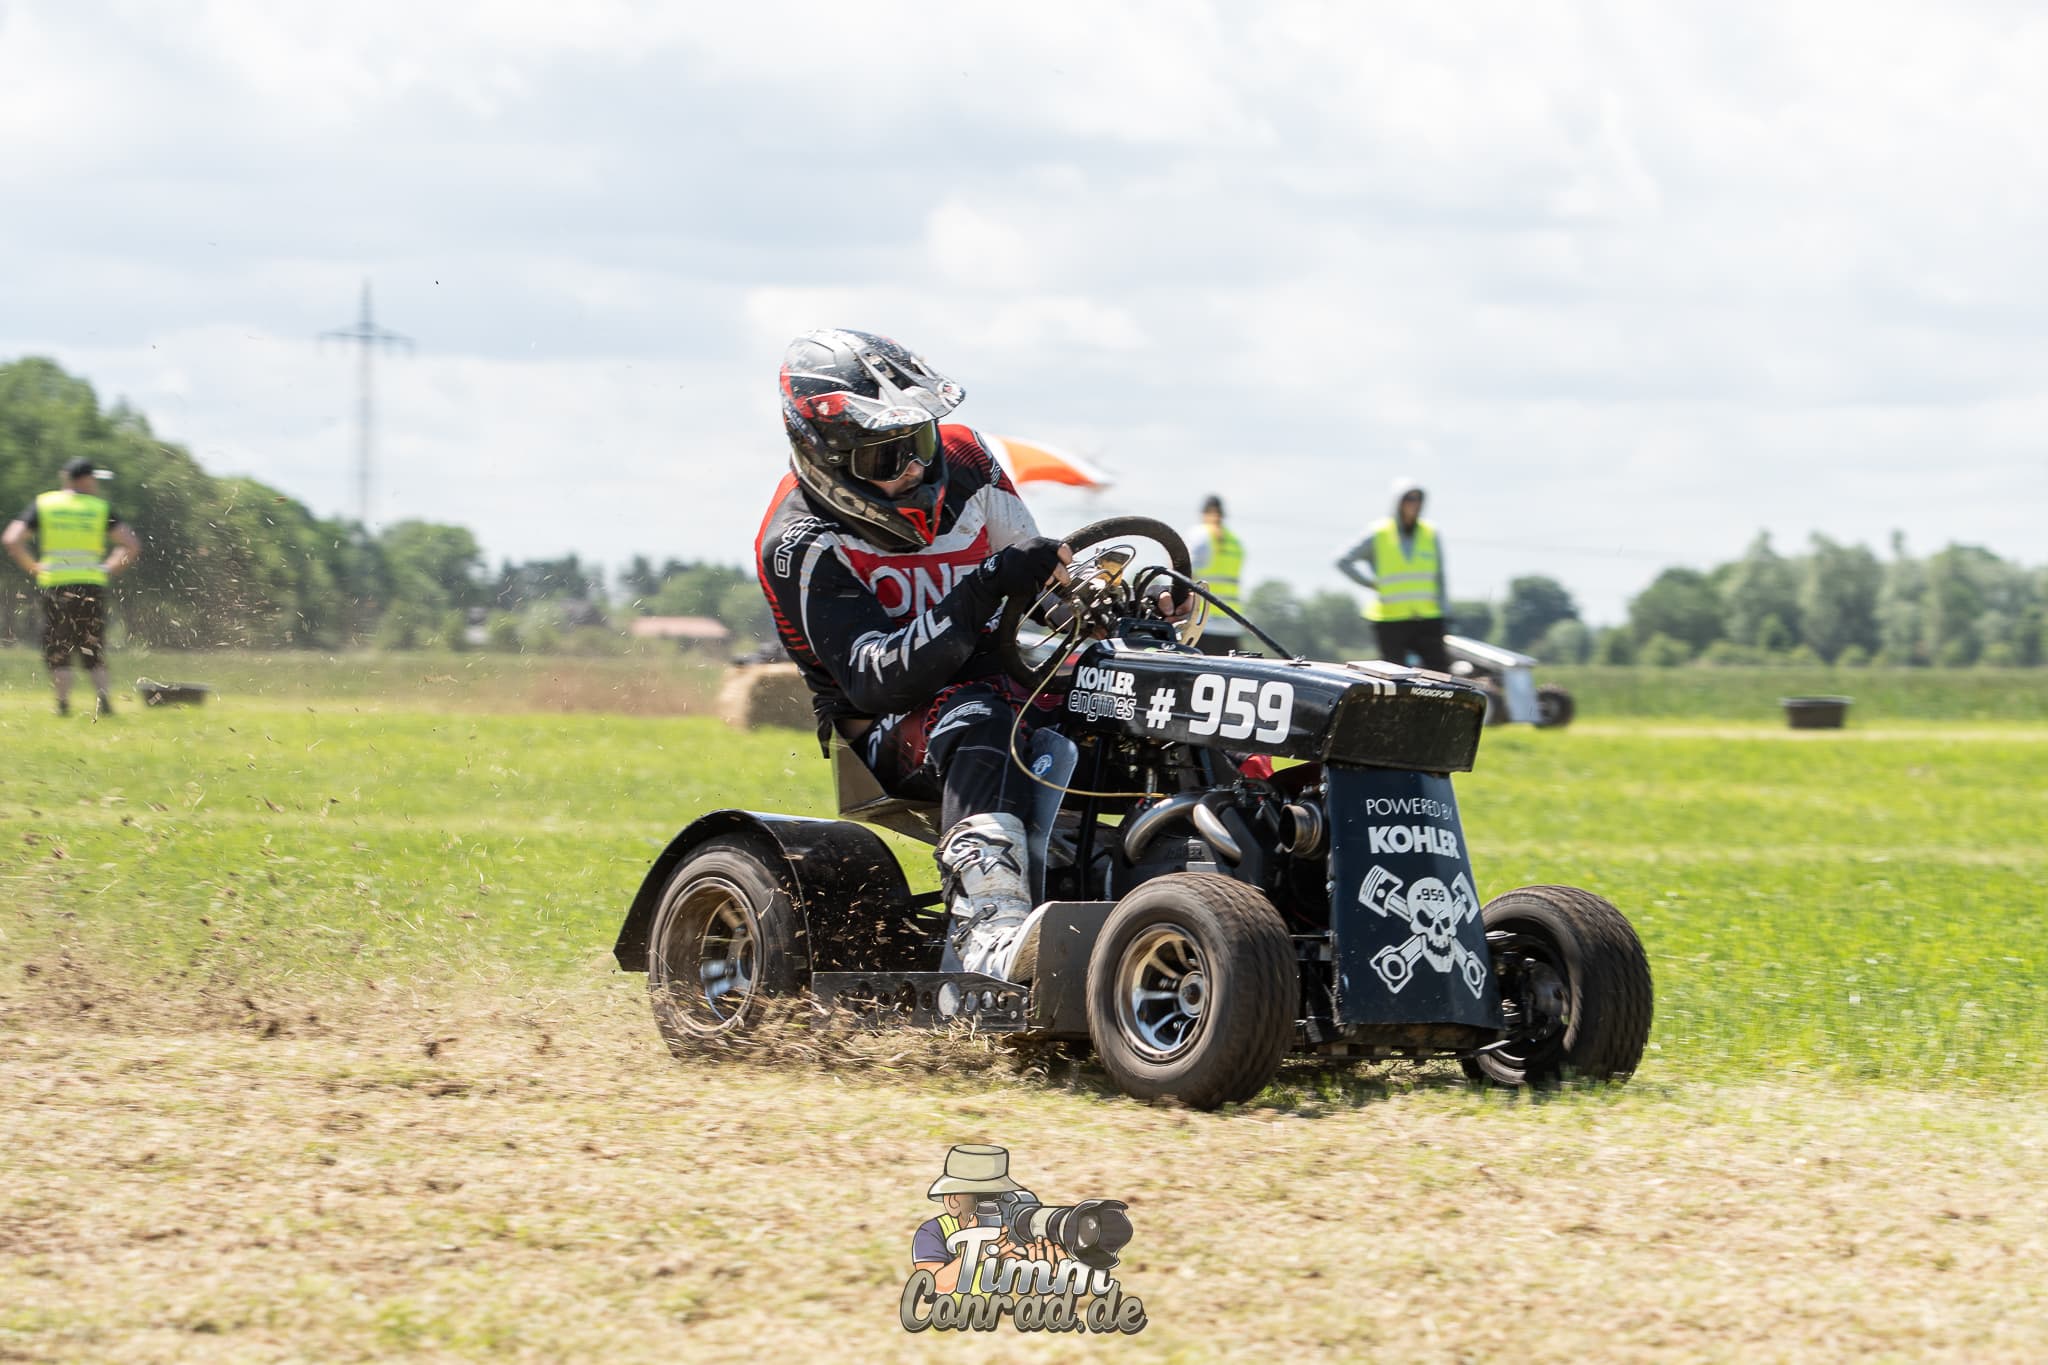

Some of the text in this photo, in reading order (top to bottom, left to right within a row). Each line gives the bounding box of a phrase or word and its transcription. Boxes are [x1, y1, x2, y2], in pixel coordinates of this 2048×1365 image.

[1067, 689, 1137, 722] engines
[1146, 674, 1294, 744] # 959
[1365, 797, 1441, 818] POWERED
[1368, 825, 1461, 860] KOHLER
